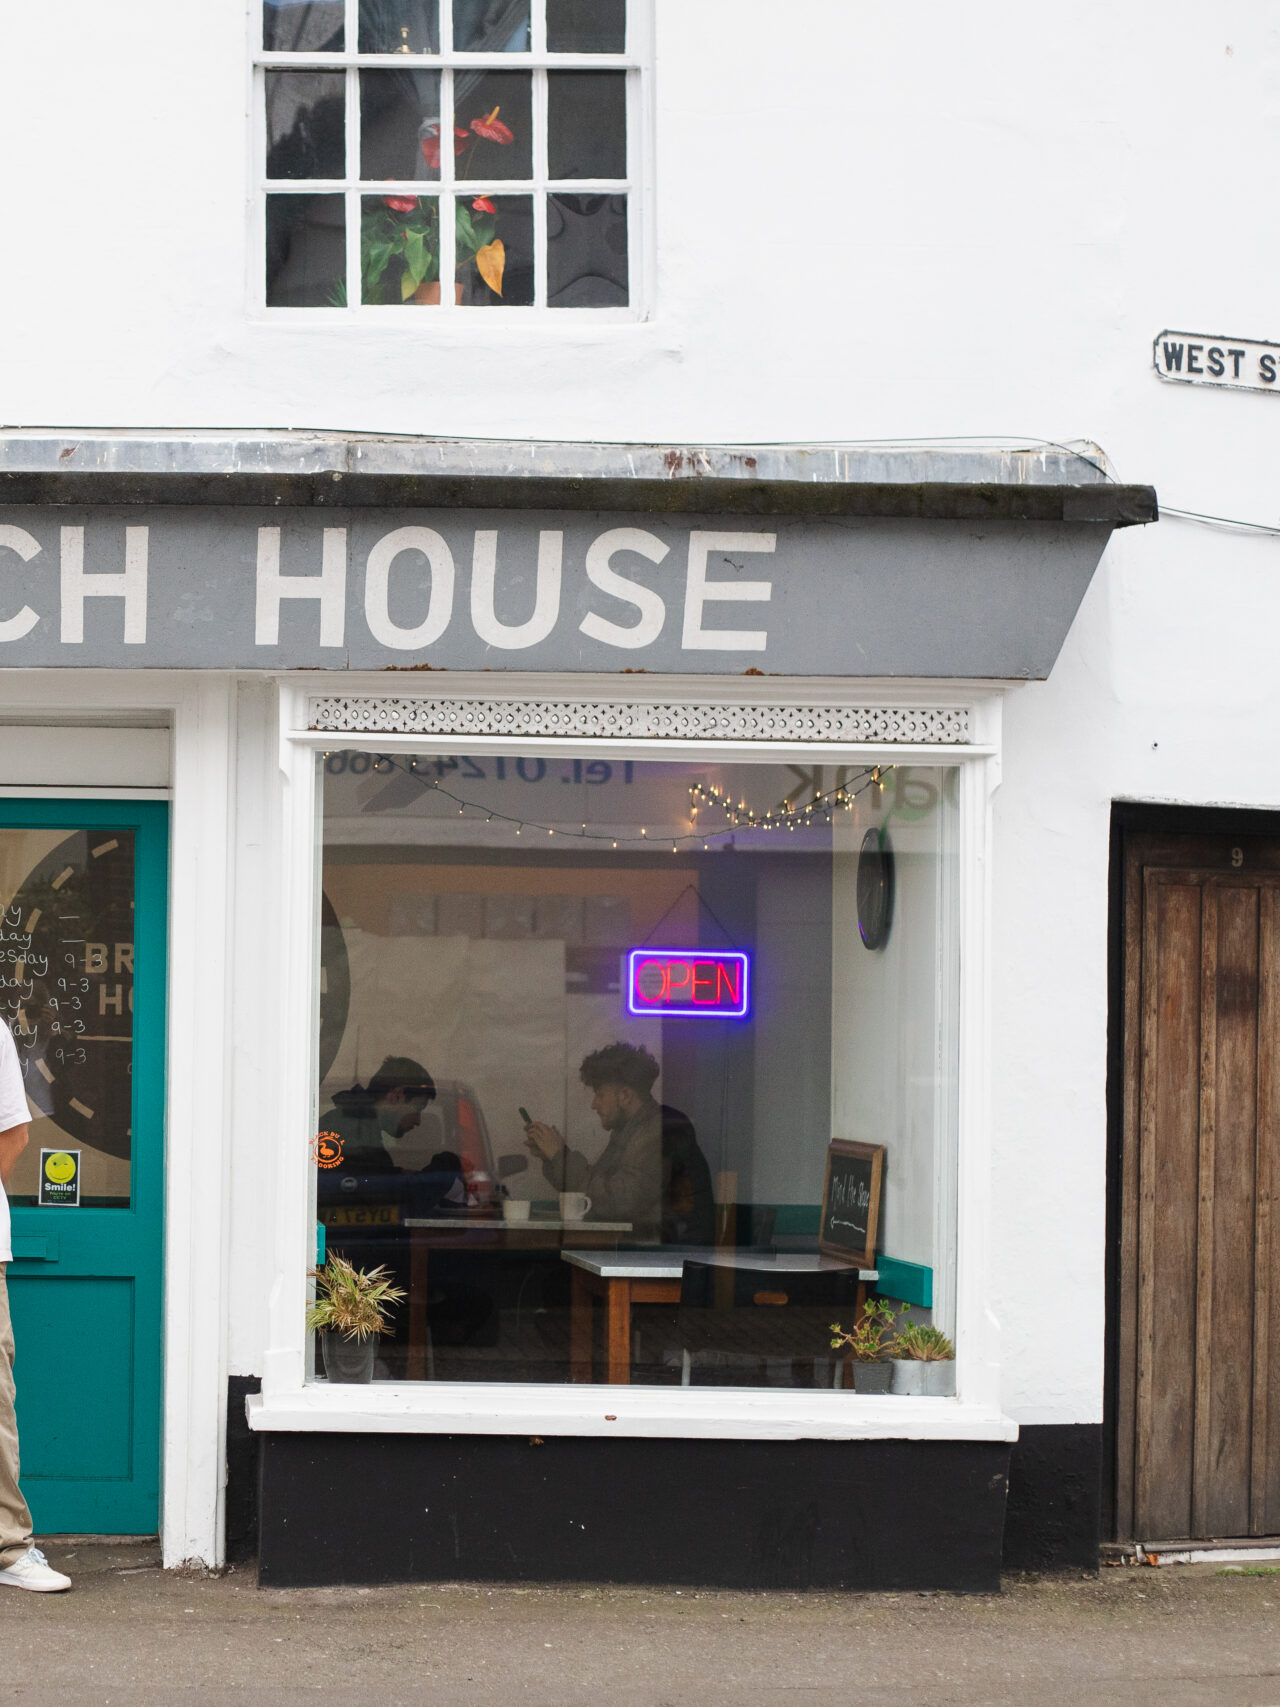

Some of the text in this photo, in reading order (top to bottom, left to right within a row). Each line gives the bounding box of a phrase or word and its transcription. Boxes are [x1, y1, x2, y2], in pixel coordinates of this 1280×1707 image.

[1163, 342, 1280, 383] WEST S
[255, 526, 777, 651] HOUSE
[1231, 847, 1244, 868] 9
[57, 977, 89, 993] 9-3
[635, 959, 740, 1005] OPEN
[48, 996, 82, 1011] 9-3
[98, 983, 134, 1016] H
[51, 1019, 86, 1035] 9-3
[55, 1047, 87, 1065] 9-3
[44, 1182, 76, 1191] Smile!
